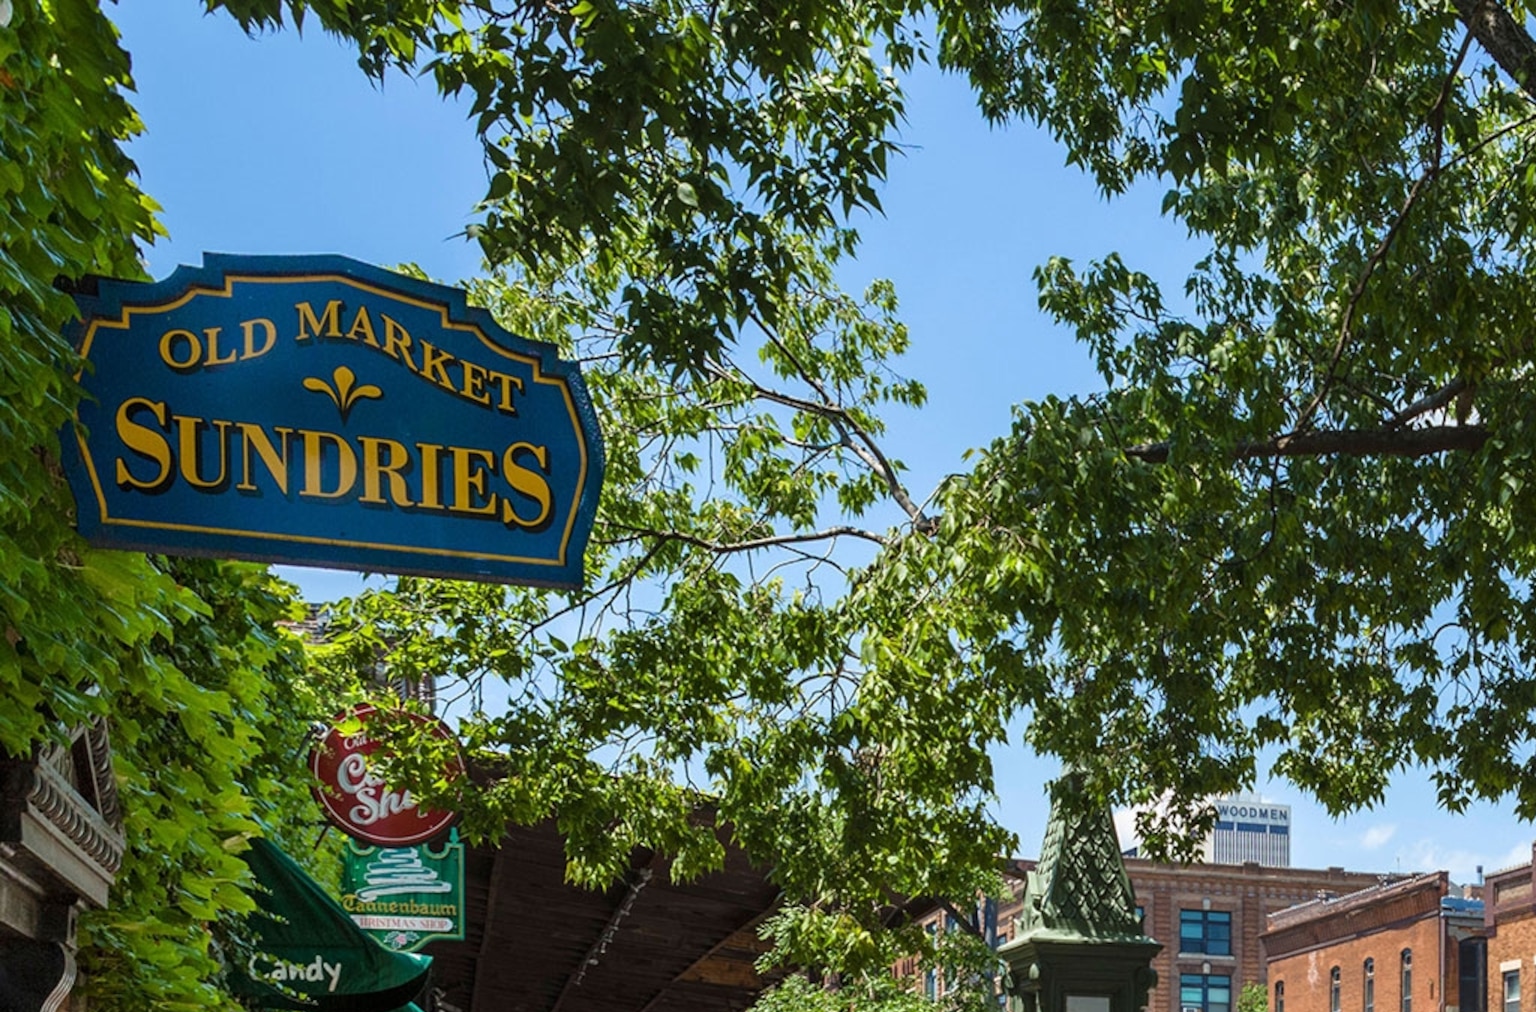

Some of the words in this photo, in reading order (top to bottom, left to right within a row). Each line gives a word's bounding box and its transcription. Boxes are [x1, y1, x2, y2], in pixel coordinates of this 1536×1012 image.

[159, 318, 277, 369] OLD
[296, 300, 523, 413] MARKET
[115, 397, 552, 528] SUNDRIES
[1218, 805, 1288, 820] WOODMEN
[342, 894, 457, 916] Tannenbaum
[360, 917, 416, 928] HRISTMAS
[248, 952, 342, 992] Candy
